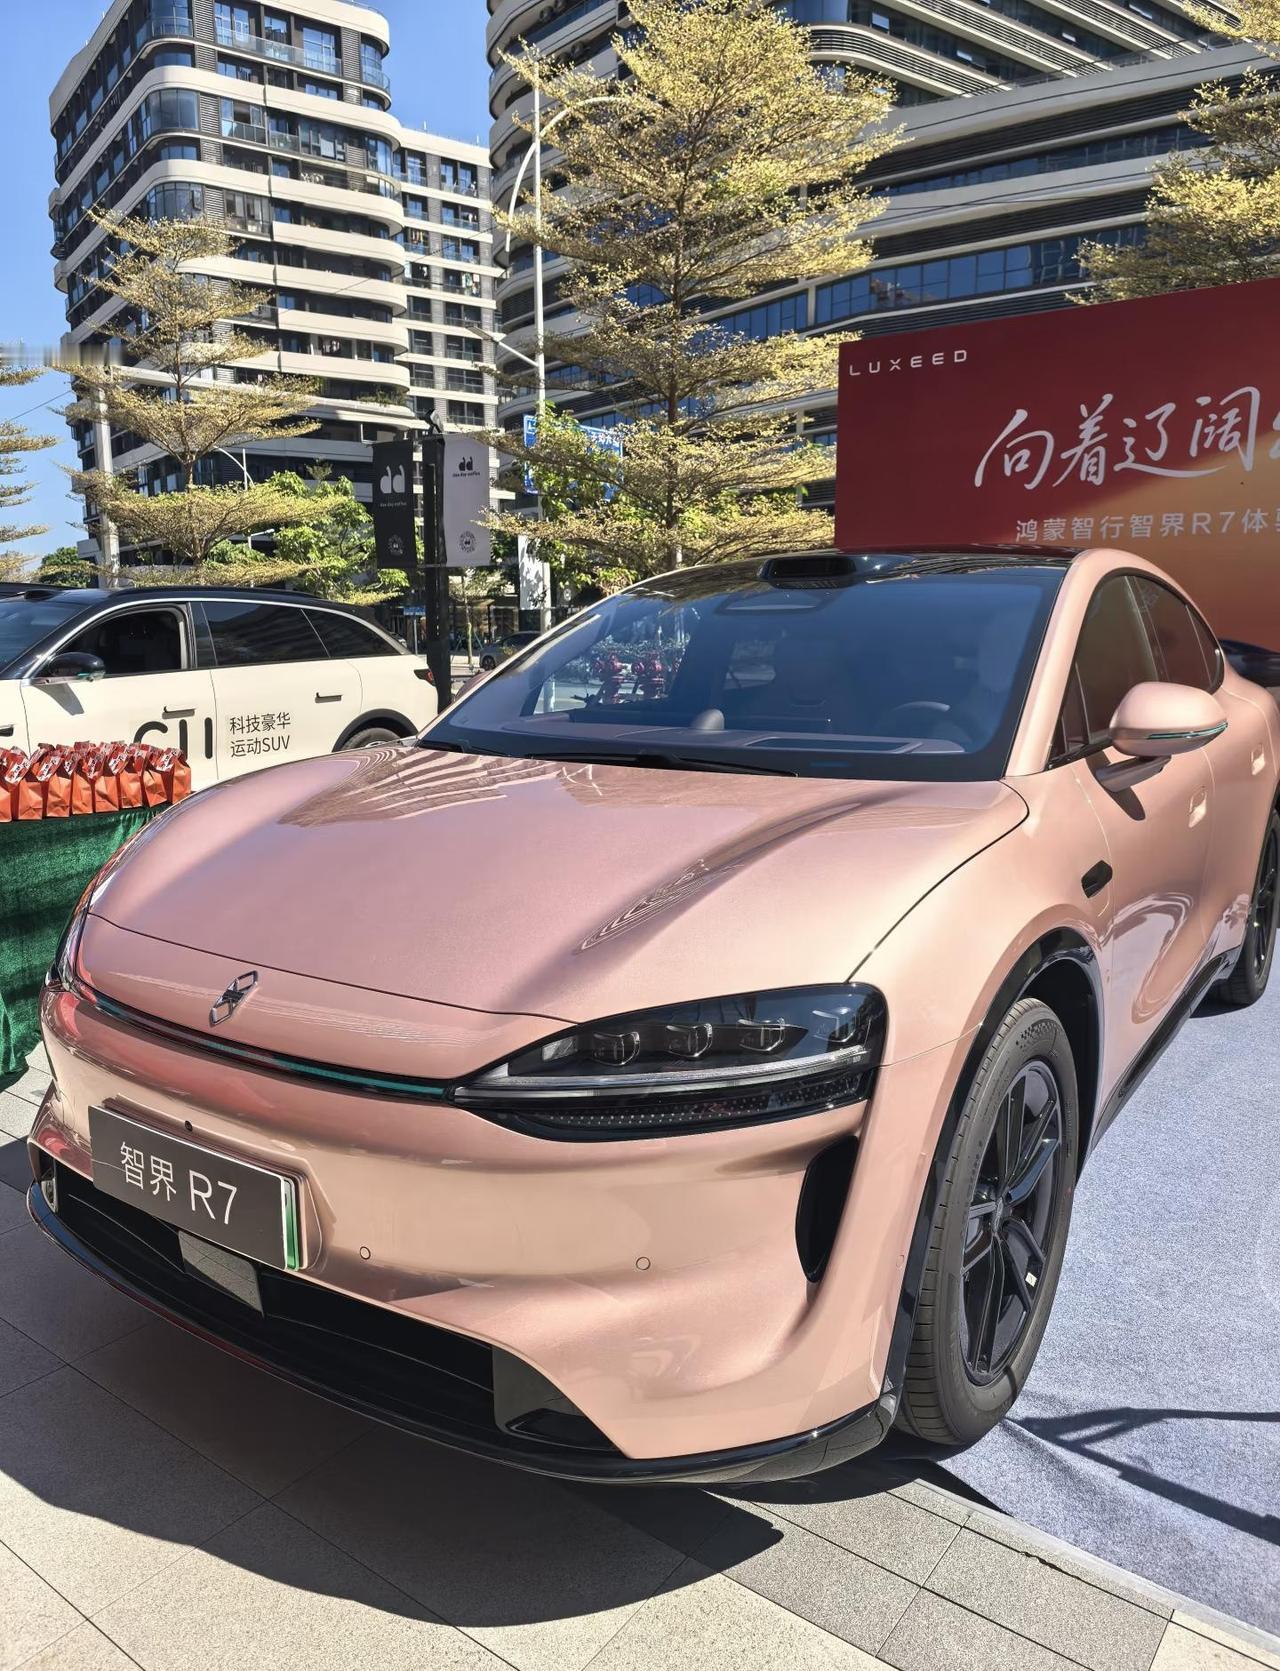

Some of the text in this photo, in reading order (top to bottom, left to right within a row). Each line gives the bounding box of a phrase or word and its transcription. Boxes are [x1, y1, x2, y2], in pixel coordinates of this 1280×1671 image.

[849, 349, 967, 377] LUXEED
[974, 386, 1280, 490] 向着辽阔
[229, 711, 291, 736] 科技豪华
[230, 735, 291, 758] 运动SUV
[120, 1141, 238, 1225] 智界 R7
